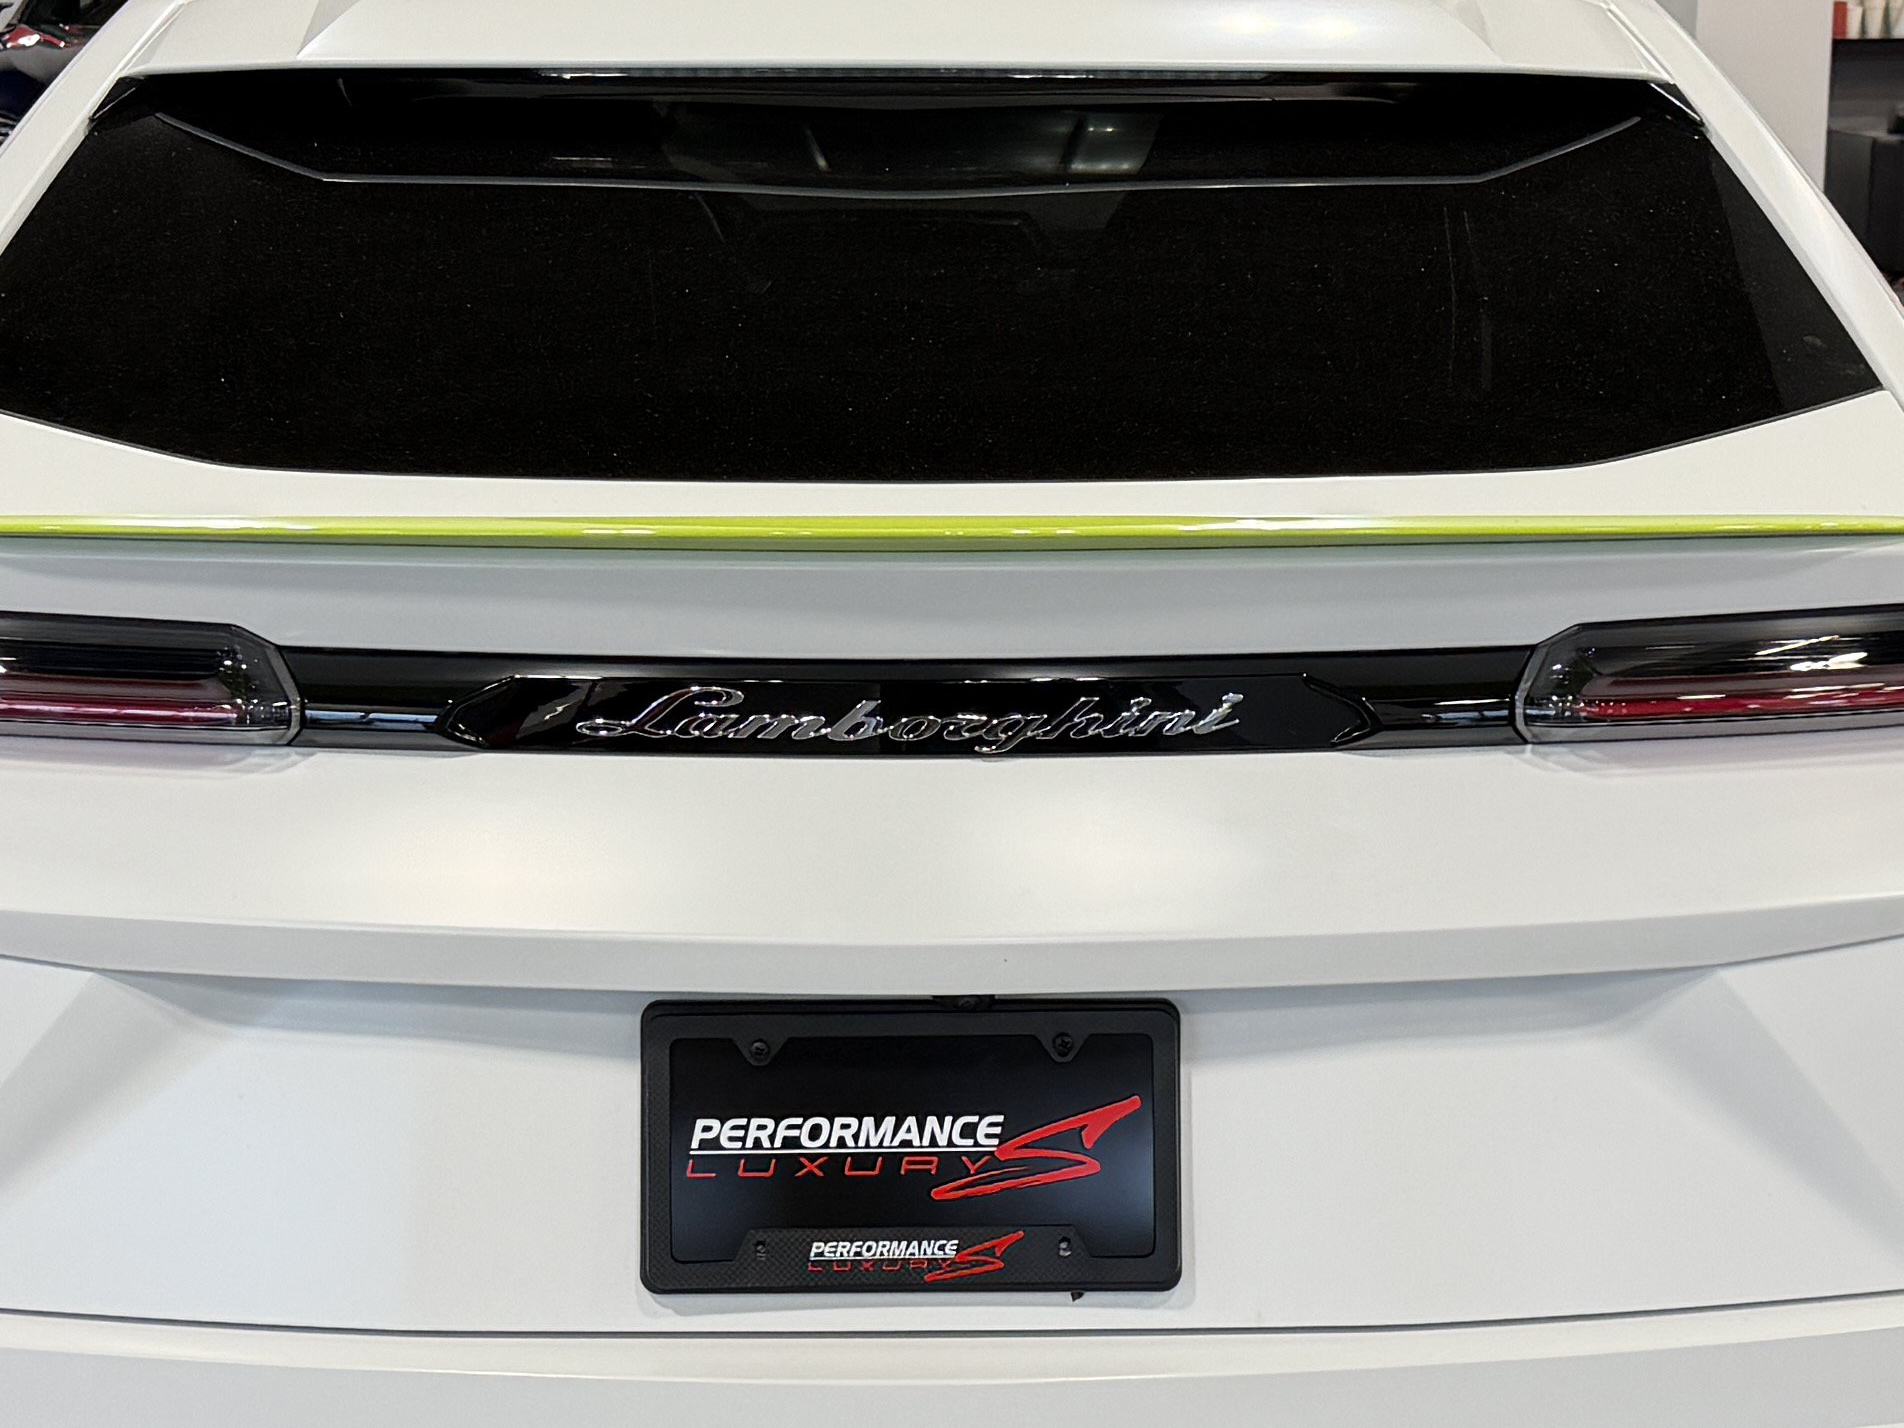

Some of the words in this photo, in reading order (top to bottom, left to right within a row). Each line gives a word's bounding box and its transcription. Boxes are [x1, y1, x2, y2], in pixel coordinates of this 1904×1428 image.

[575, 685, 1244, 754] Lamborghini
[689, 1114, 1004, 1149] PERFORMANCE
[686, 1155, 992, 1178] LUXURY
[809, 1239, 959, 1258] PERFORMANCE
[807, 1259, 953, 1273] LUXURY
